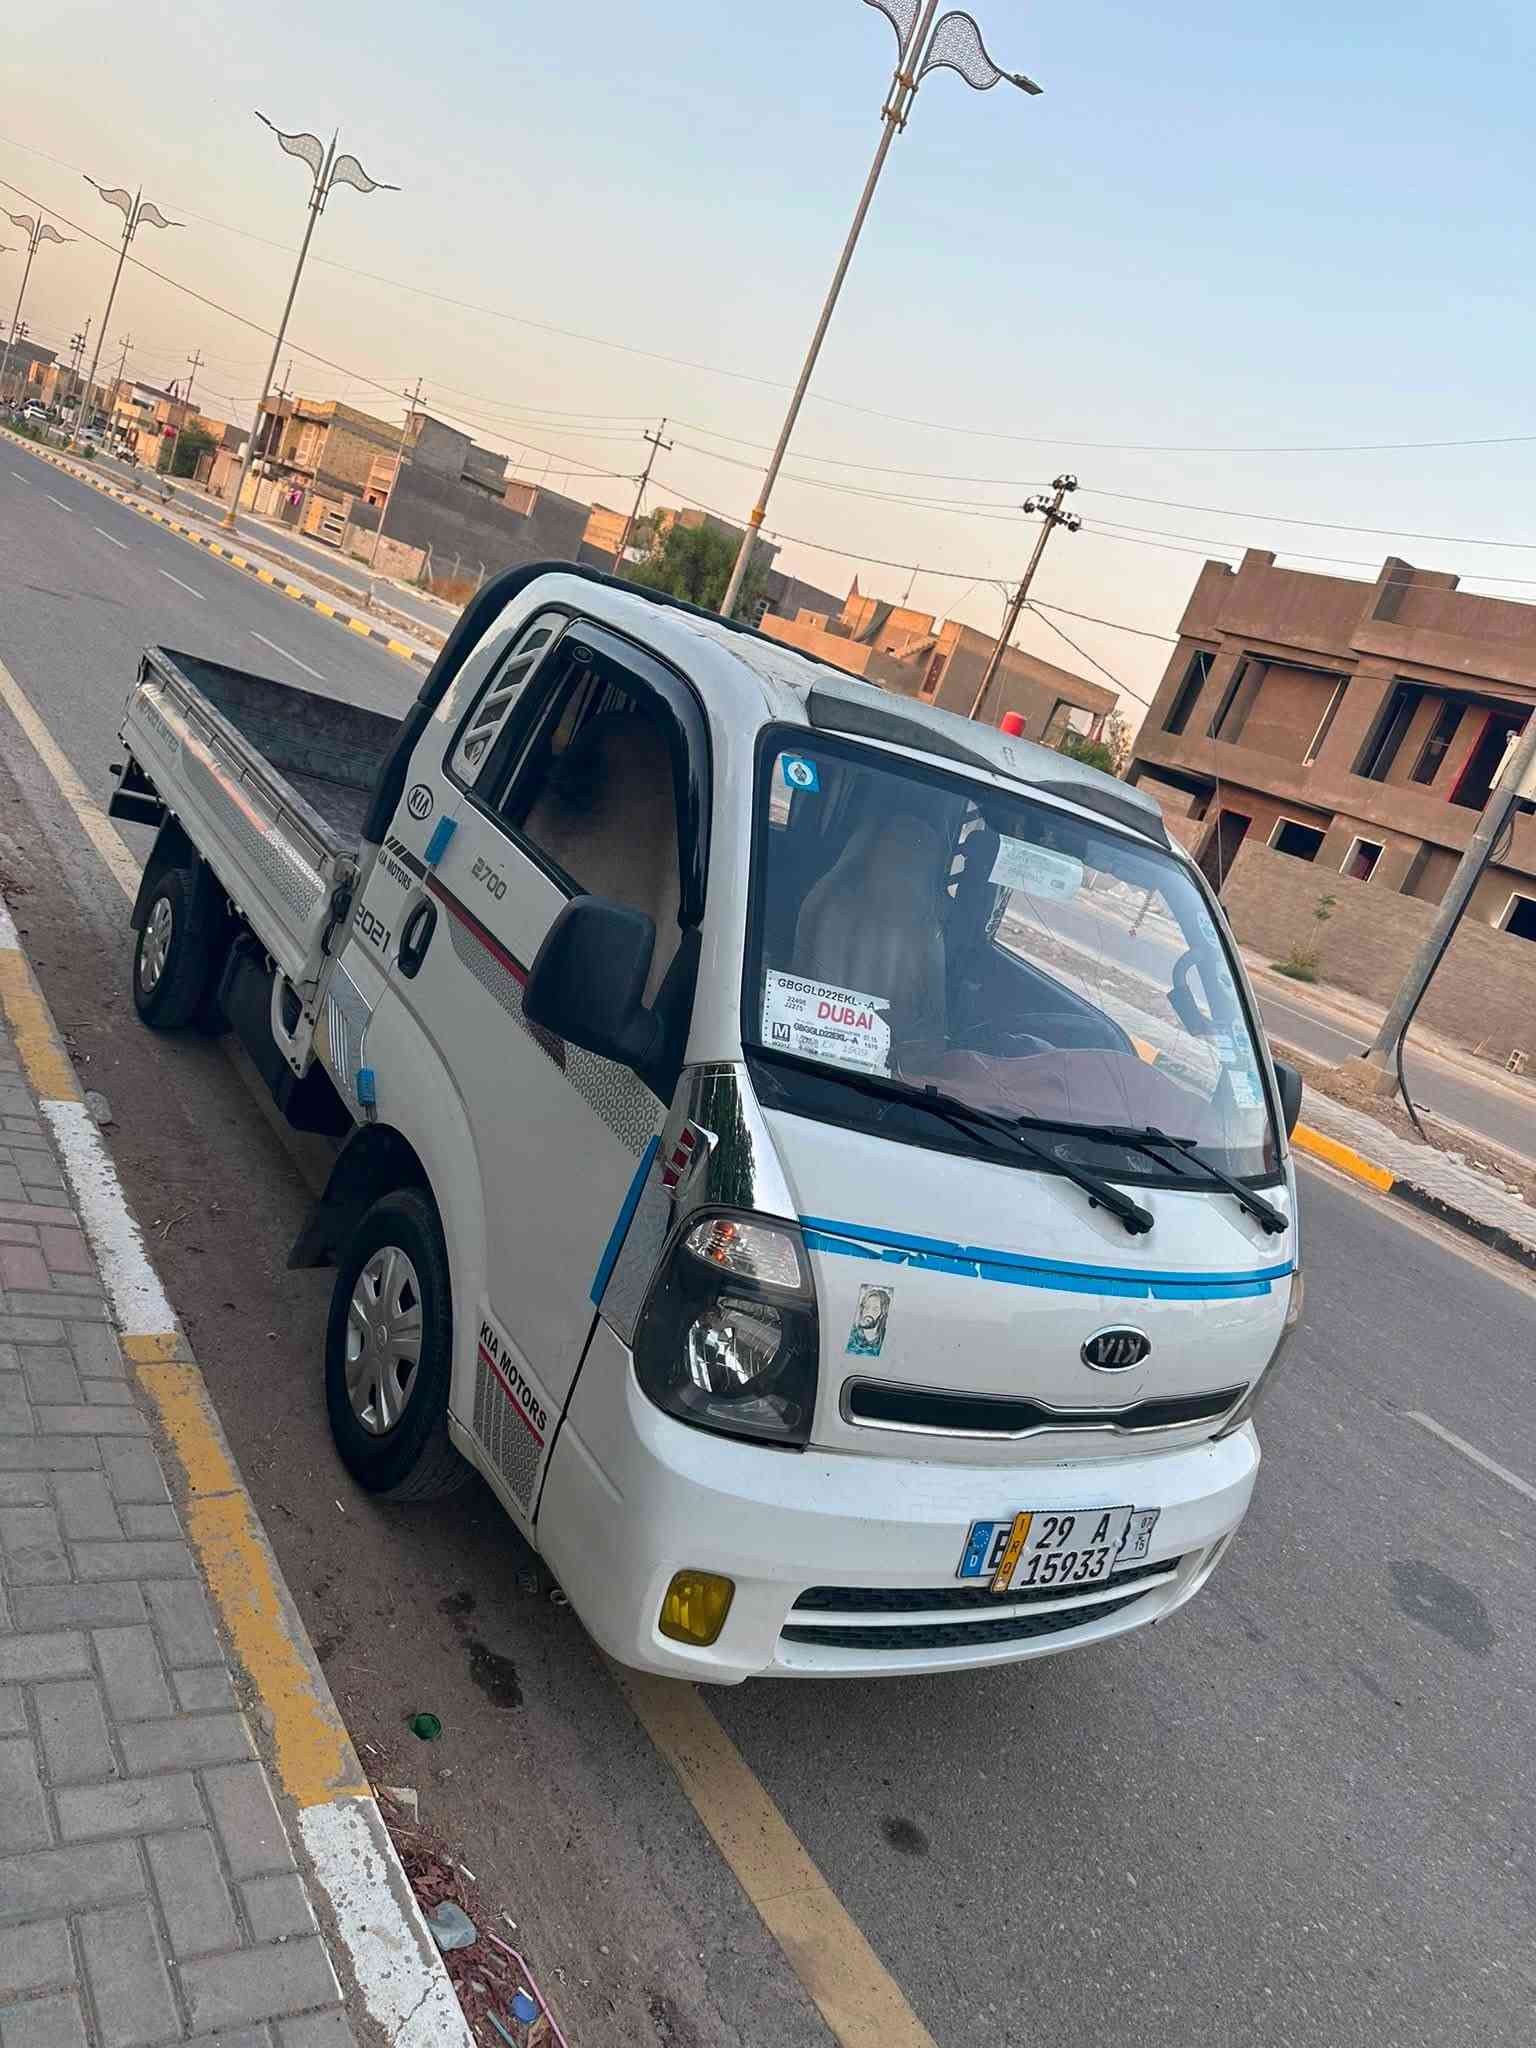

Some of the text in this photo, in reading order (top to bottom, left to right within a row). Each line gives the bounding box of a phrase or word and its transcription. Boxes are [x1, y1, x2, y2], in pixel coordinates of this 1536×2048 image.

[409, 788, 428, 816] KIA
[388, 861, 413, 890] MOTORS
[472, 856, 507, 900] 2700
[354, 903, 391, 952] 2021
[817, 1001, 873, 1030] DUBAI
[772, 1022, 791, 1042] M
[1097, 1337, 1141, 1364] KIA
[480, 1321, 548, 1432] KIA MOTORS
[1035, 1512, 1110, 1549] 29 A
[969, 1555, 978, 1567] D
[1020, 1546, 1110, 1586] 15933
